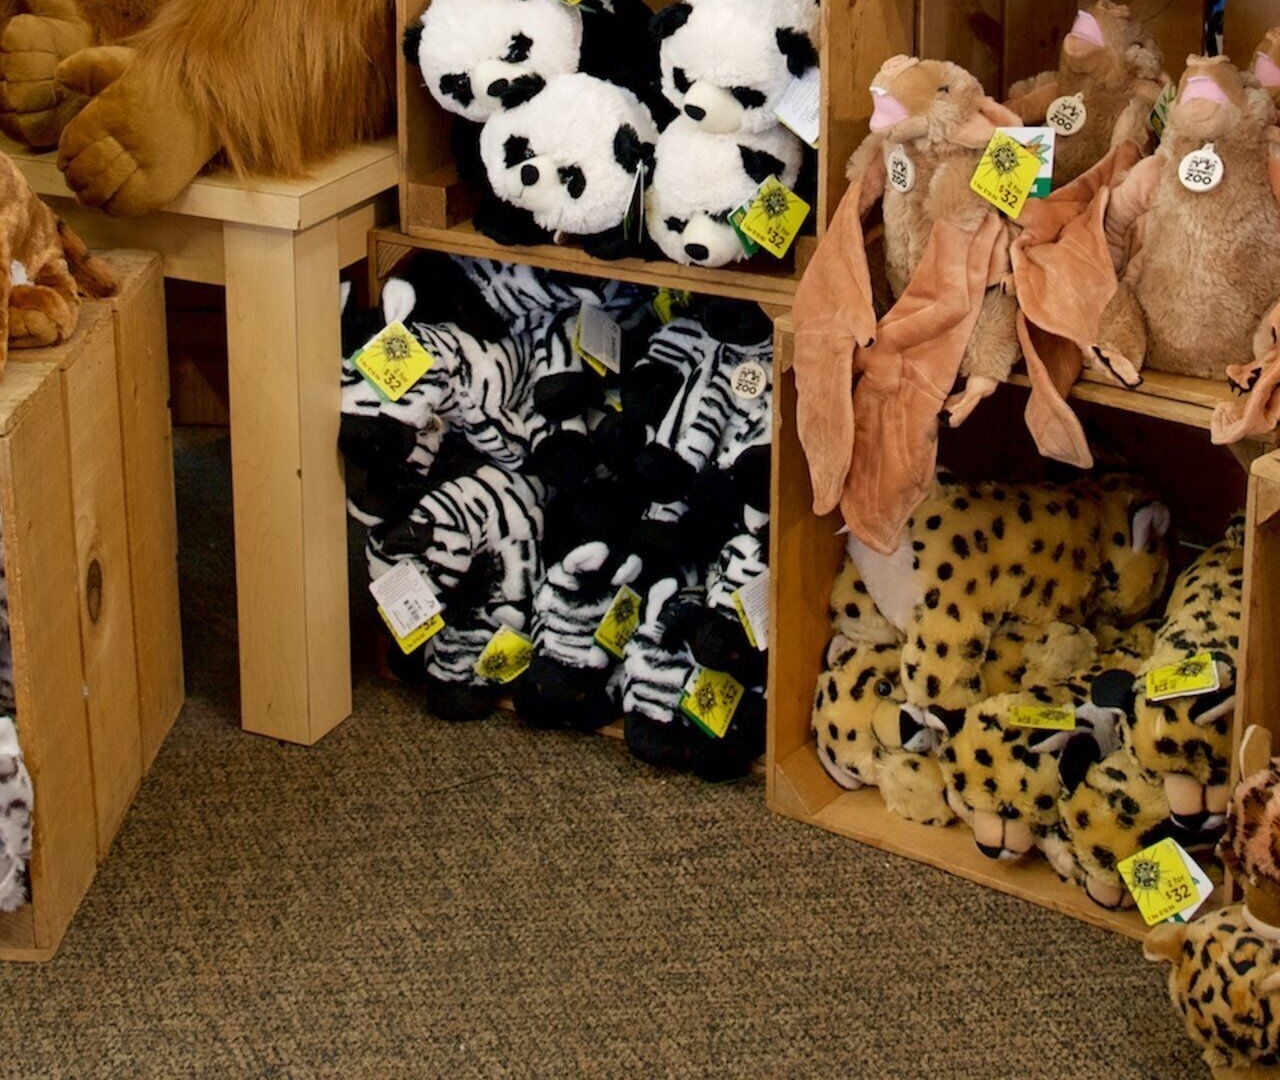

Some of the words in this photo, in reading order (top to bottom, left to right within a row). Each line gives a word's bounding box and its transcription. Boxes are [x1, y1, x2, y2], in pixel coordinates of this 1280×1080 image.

[1050, 113, 1072, 131] ZOO
[1185, 172, 1211, 185] ZOO
[999, 184, 1018, 208] $32
[767, 226, 785, 249] $32
[383, 368, 401, 392] $32
[735, 382, 757, 395] ZOO
[1173, 875, 1184, 883] for
[1165, 883, 1191, 903] $32
